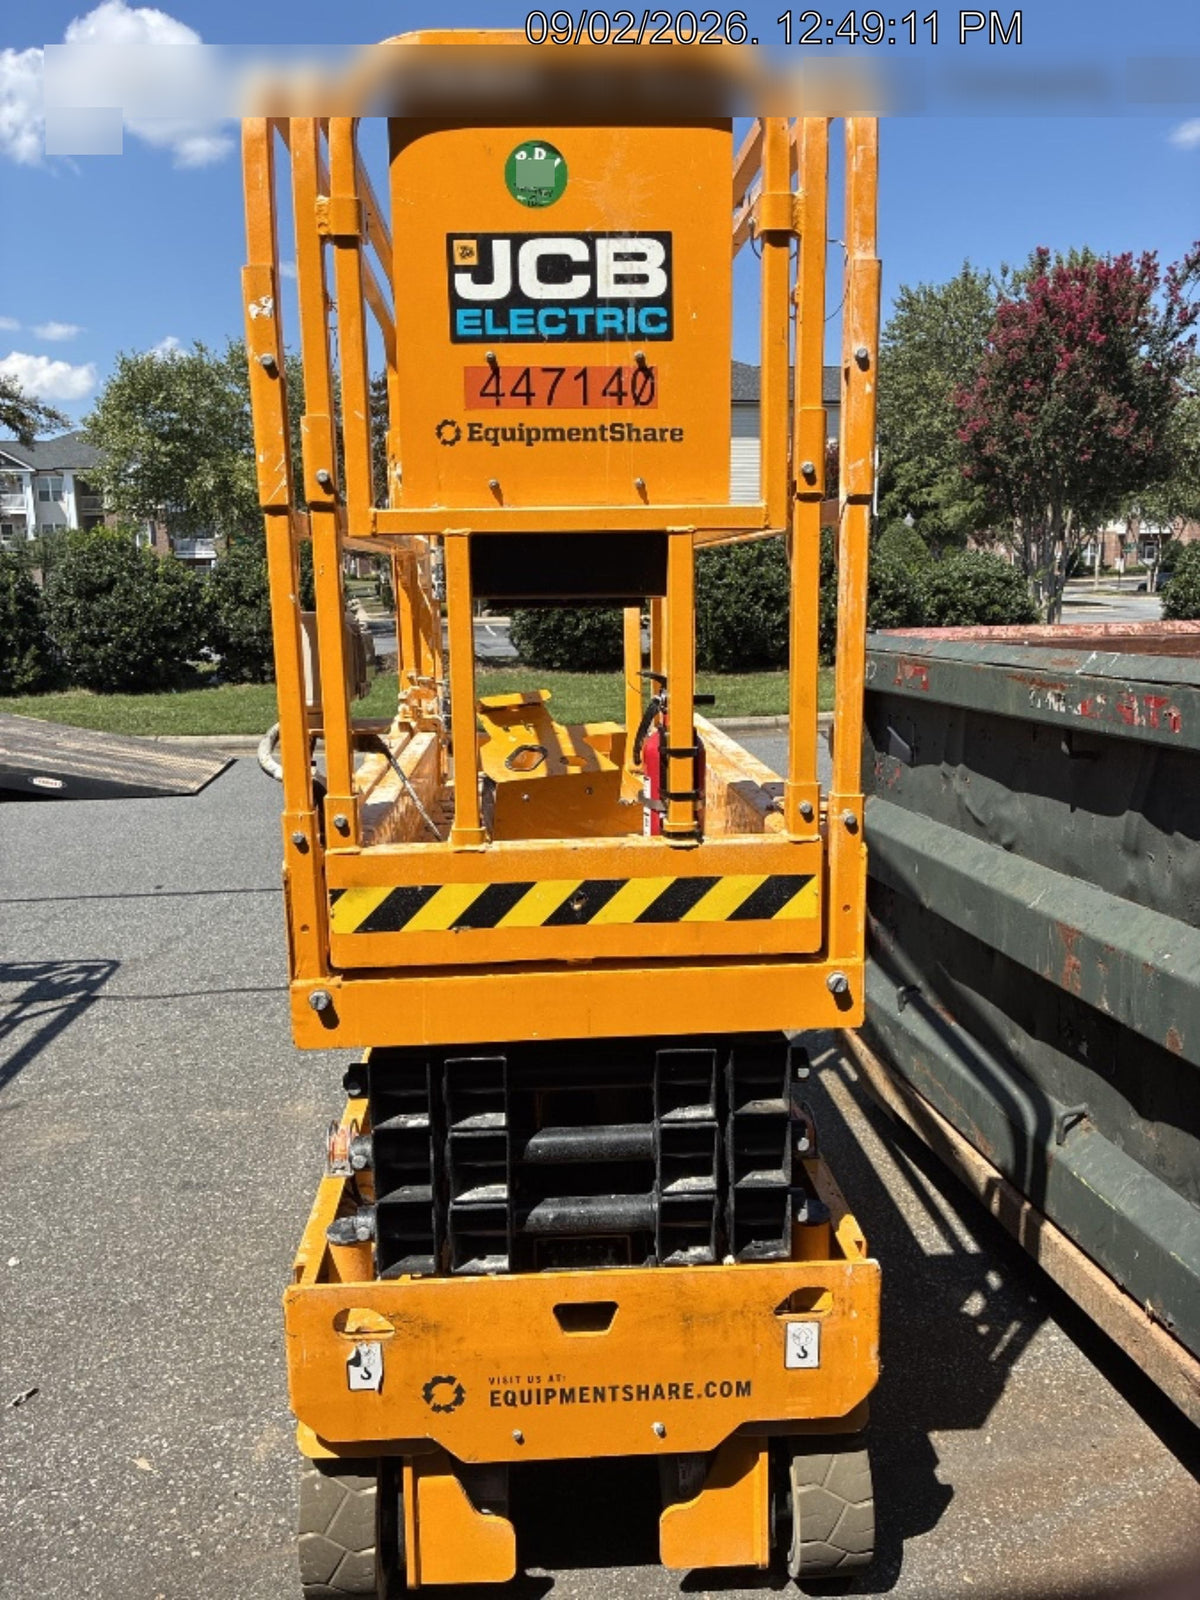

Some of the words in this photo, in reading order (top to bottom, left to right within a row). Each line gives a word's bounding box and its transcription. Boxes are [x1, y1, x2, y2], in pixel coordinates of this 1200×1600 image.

[453, 237, 668, 301] JCB
[456, 306, 668, 337] ELECTRIC
[479, 366, 656, 406] 447140
[467, 422, 684, 447] EquipmentShare
[488, 1375, 521, 1386] VISIT
[527, 1374, 542, 1384] US
[490, 1380, 752, 1408] EQUIPMENTSHARE.COM
